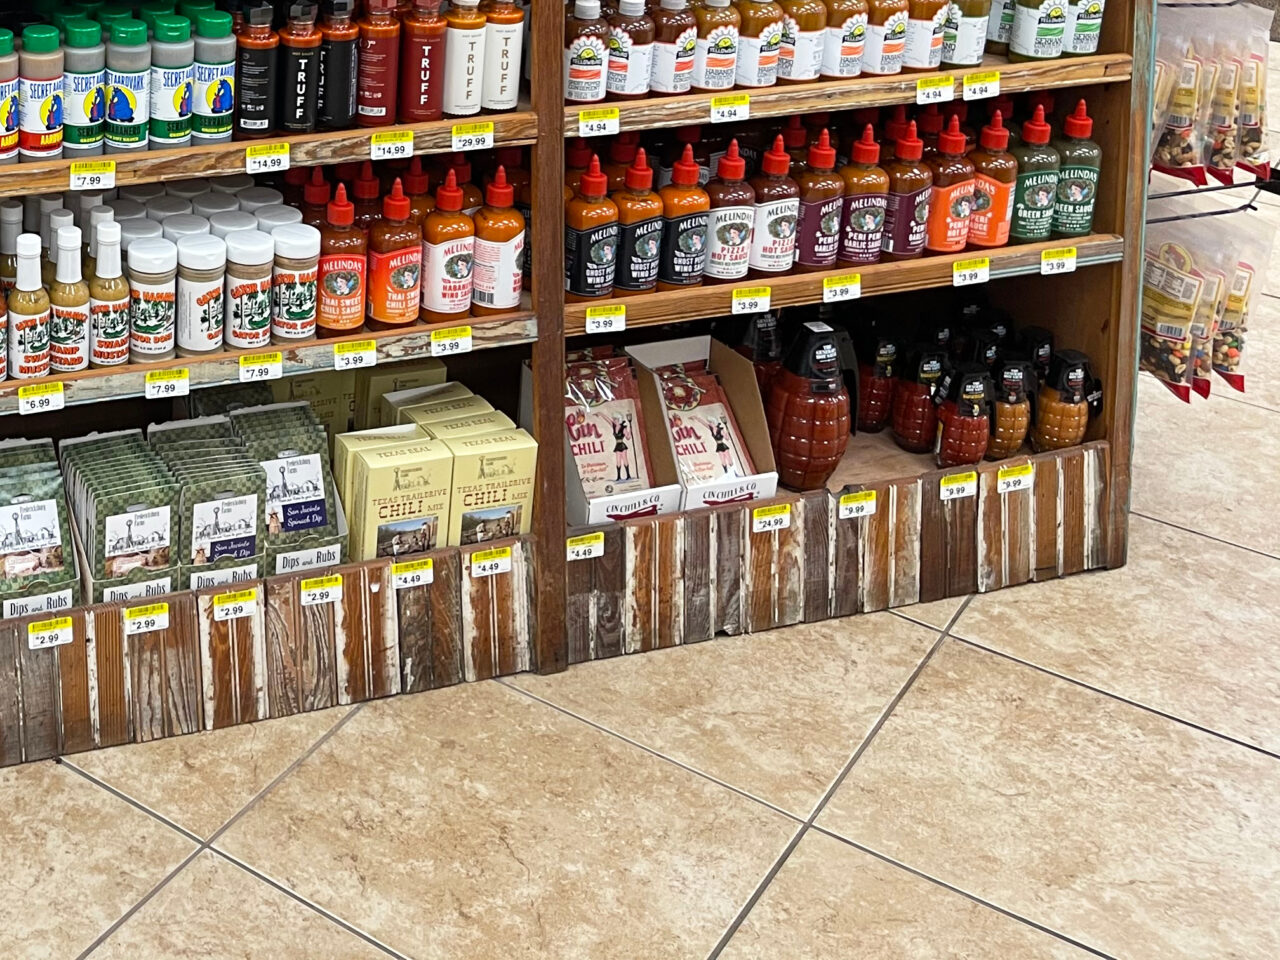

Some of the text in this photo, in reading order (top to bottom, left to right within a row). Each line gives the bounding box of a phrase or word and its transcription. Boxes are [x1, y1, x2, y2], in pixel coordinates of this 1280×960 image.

[114, 75, 145, 90] AARDVARK
[420, 45, 432, 104] TRUFF
[29, 83, 50, 99] SECRET
[296, 59, 308, 119] TRUFF
[721, 246, 745, 254] PIZZA
[321, 304, 361, 314] CHILI SAUCE
[322, 296, 362, 306] THAI SWEET
[376, 449, 404, 459] TEXAS
[571, 441, 606, 456] CHILI
[456, 477, 532, 494] TEXAS TRAILDRIVE
[372, 488, 448, 506] TEXAS TRAILDRIVE
[462, 489, 528, 506] CHILI MIX
[287, 507, 299, 516] San
[378, 501, 444, 518] CHILI MIX
[287, 514, 323, 527] Spinach Dip
[282, 550, 336, 569] Dips and Rubs
[10, 596, 68, 616] Dips and Rubs
